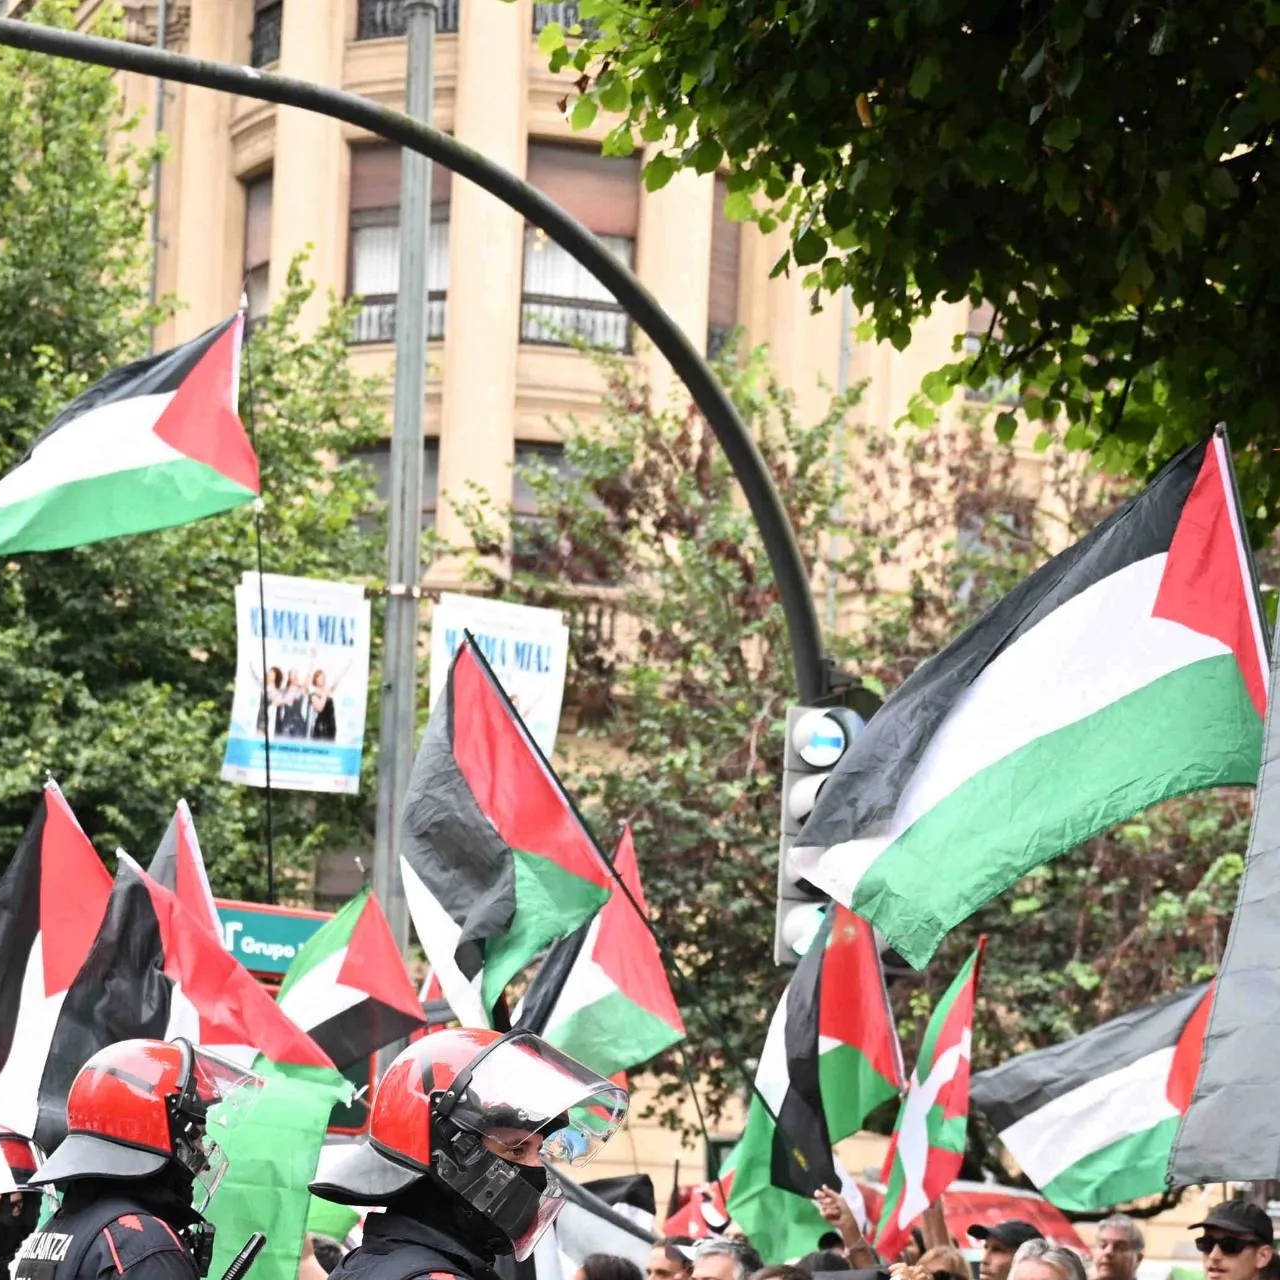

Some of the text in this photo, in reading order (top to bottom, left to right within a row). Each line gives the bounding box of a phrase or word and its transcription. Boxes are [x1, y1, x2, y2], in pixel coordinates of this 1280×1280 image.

[317, 614, 356, 647] MIA!
[445, 628, 551, 673] MMA MIA!
[241, 936, 296, 961] Grupo
